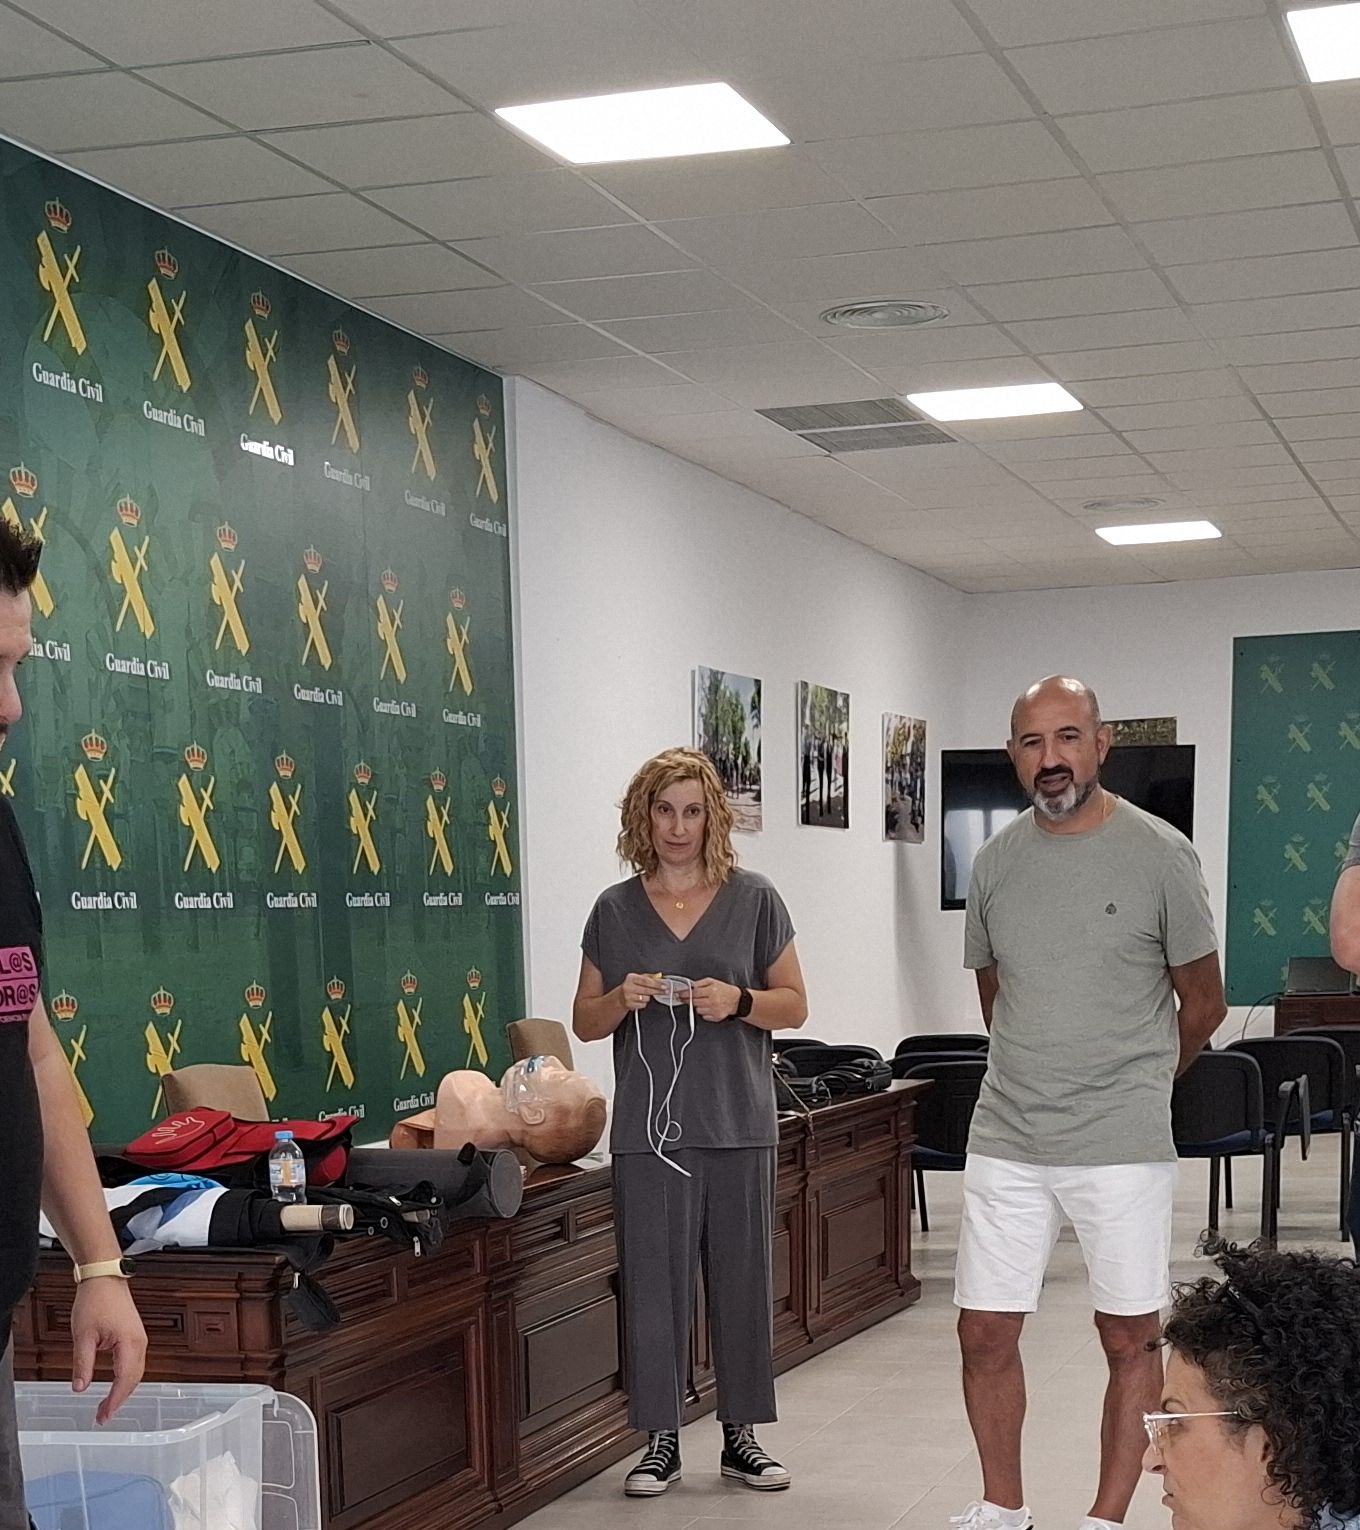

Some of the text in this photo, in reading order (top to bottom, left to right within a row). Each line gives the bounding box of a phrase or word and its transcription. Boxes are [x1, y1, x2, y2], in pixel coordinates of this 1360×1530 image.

[32, 361, 103, 403] Guardia Civil
[143, 400, 205, 437] Guardia Civil
[240, 433, 294, 467] Guardia Civil
[324, 461, 370, 491] Guardia Civil
[45, 640, 71, 661] Civil
[106, 653, 169, 680] Guardia Civil
[206, 669, 262, 694] Guardia Civil
[294, 684, 343, 706] Guardia Civil
[373, 696, 416, 718] Guardia Civil
[71, 892, 137, 910] Guardia Civil
[175, 892, 234, 910] Guardia Civil
[266, 892, 317, 910] Guardia Civil
[346, 892, 390, 907] Guardia Civil
[423, 892, 463, 907] Guardia Civil
